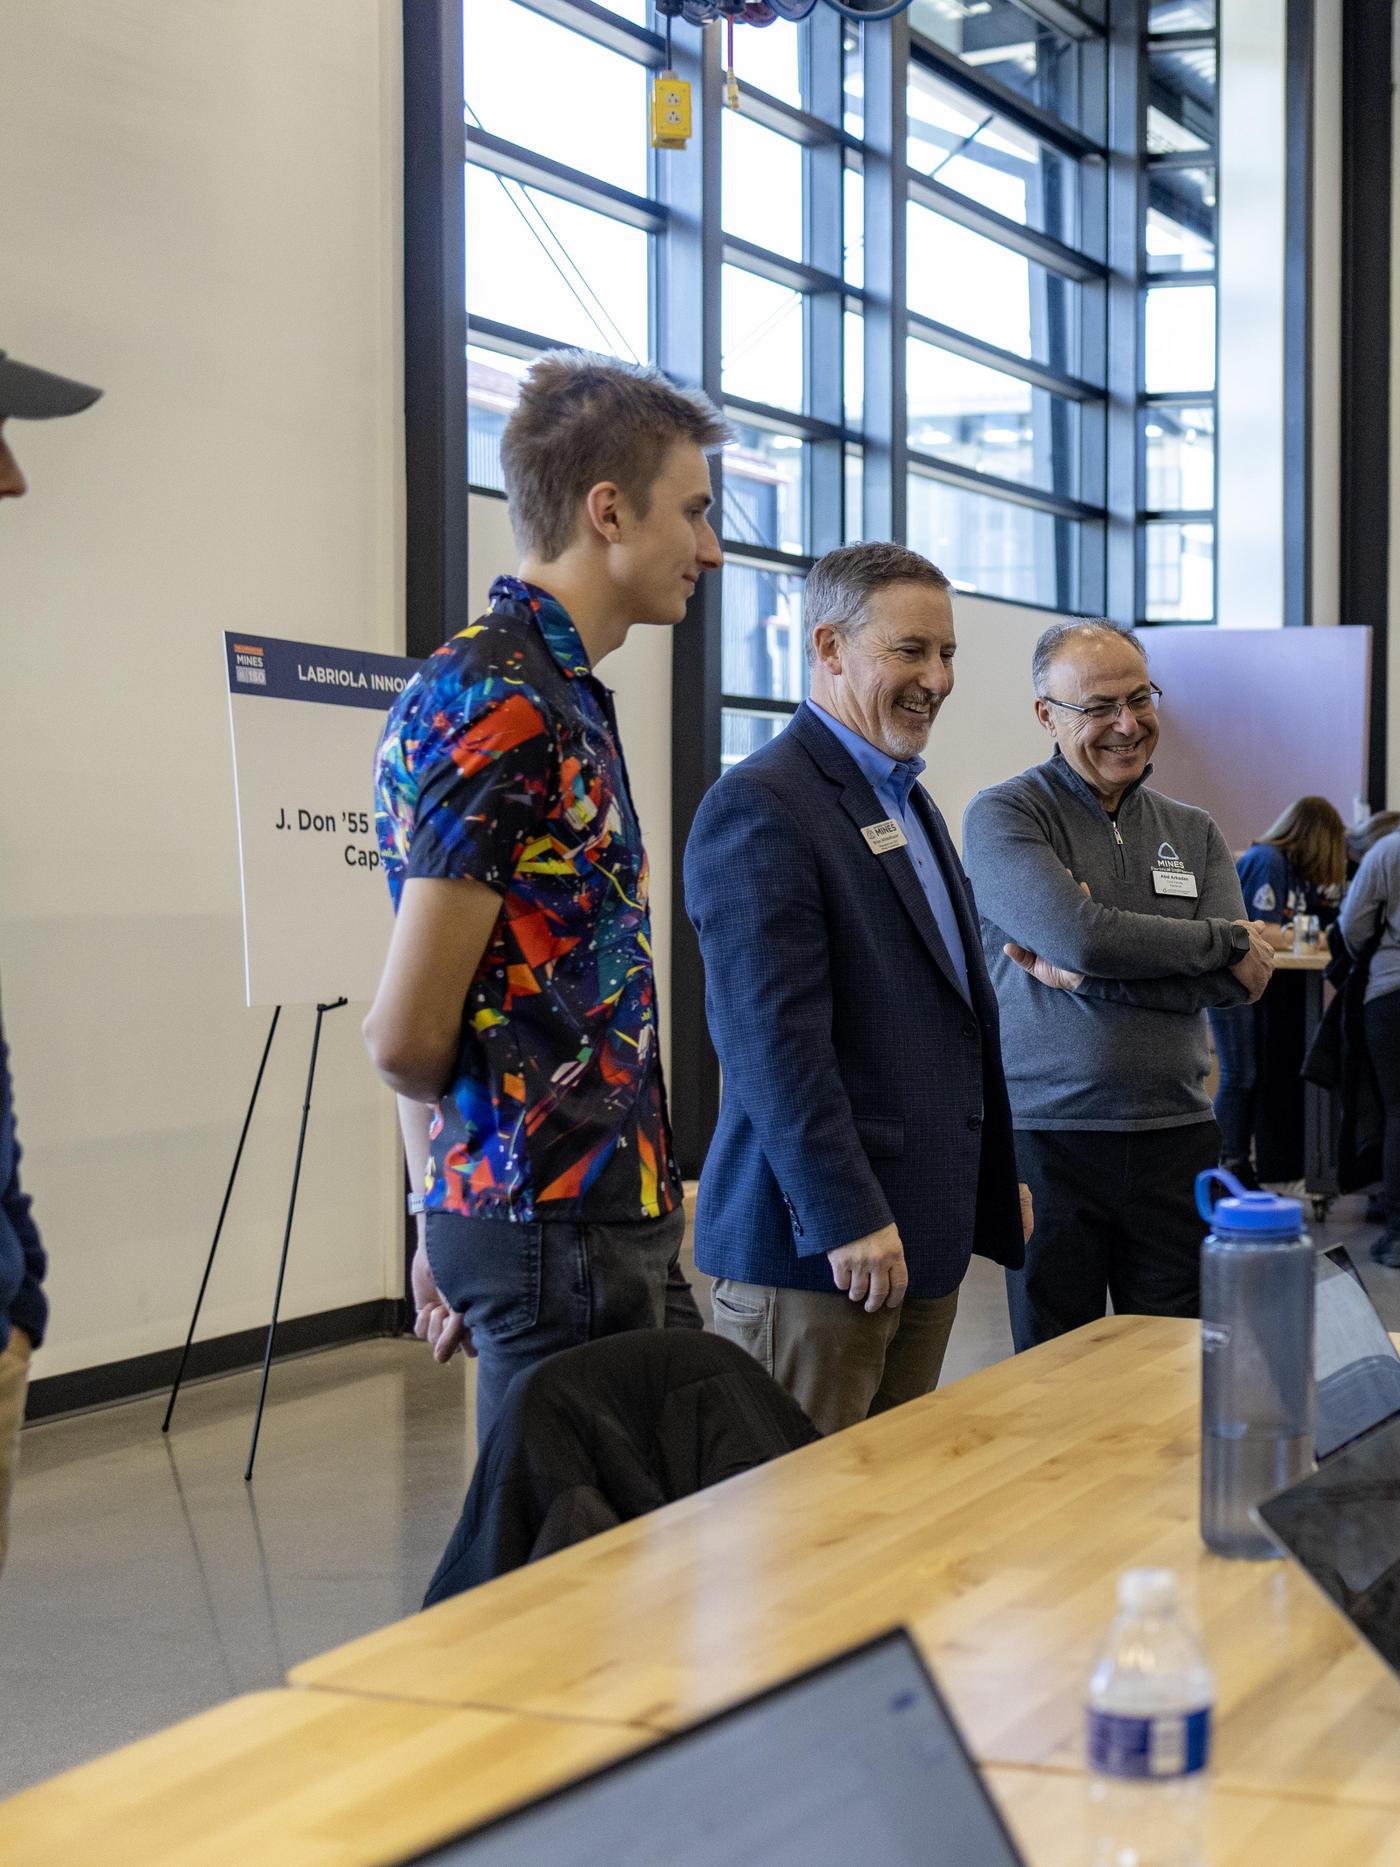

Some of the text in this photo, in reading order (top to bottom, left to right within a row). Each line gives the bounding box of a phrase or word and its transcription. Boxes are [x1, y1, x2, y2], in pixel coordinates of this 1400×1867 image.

[236, 653, 264, 668] MINES
[297, 664, 368, 689] LABRIOLA
[275, 807, 292, 830] J.
[298, 808, 336, 832] Don
[874, 823, 898, 837] MINES
[344, 844, 384, 872] Cap
[1157, 860, 1185, 869] MINES
